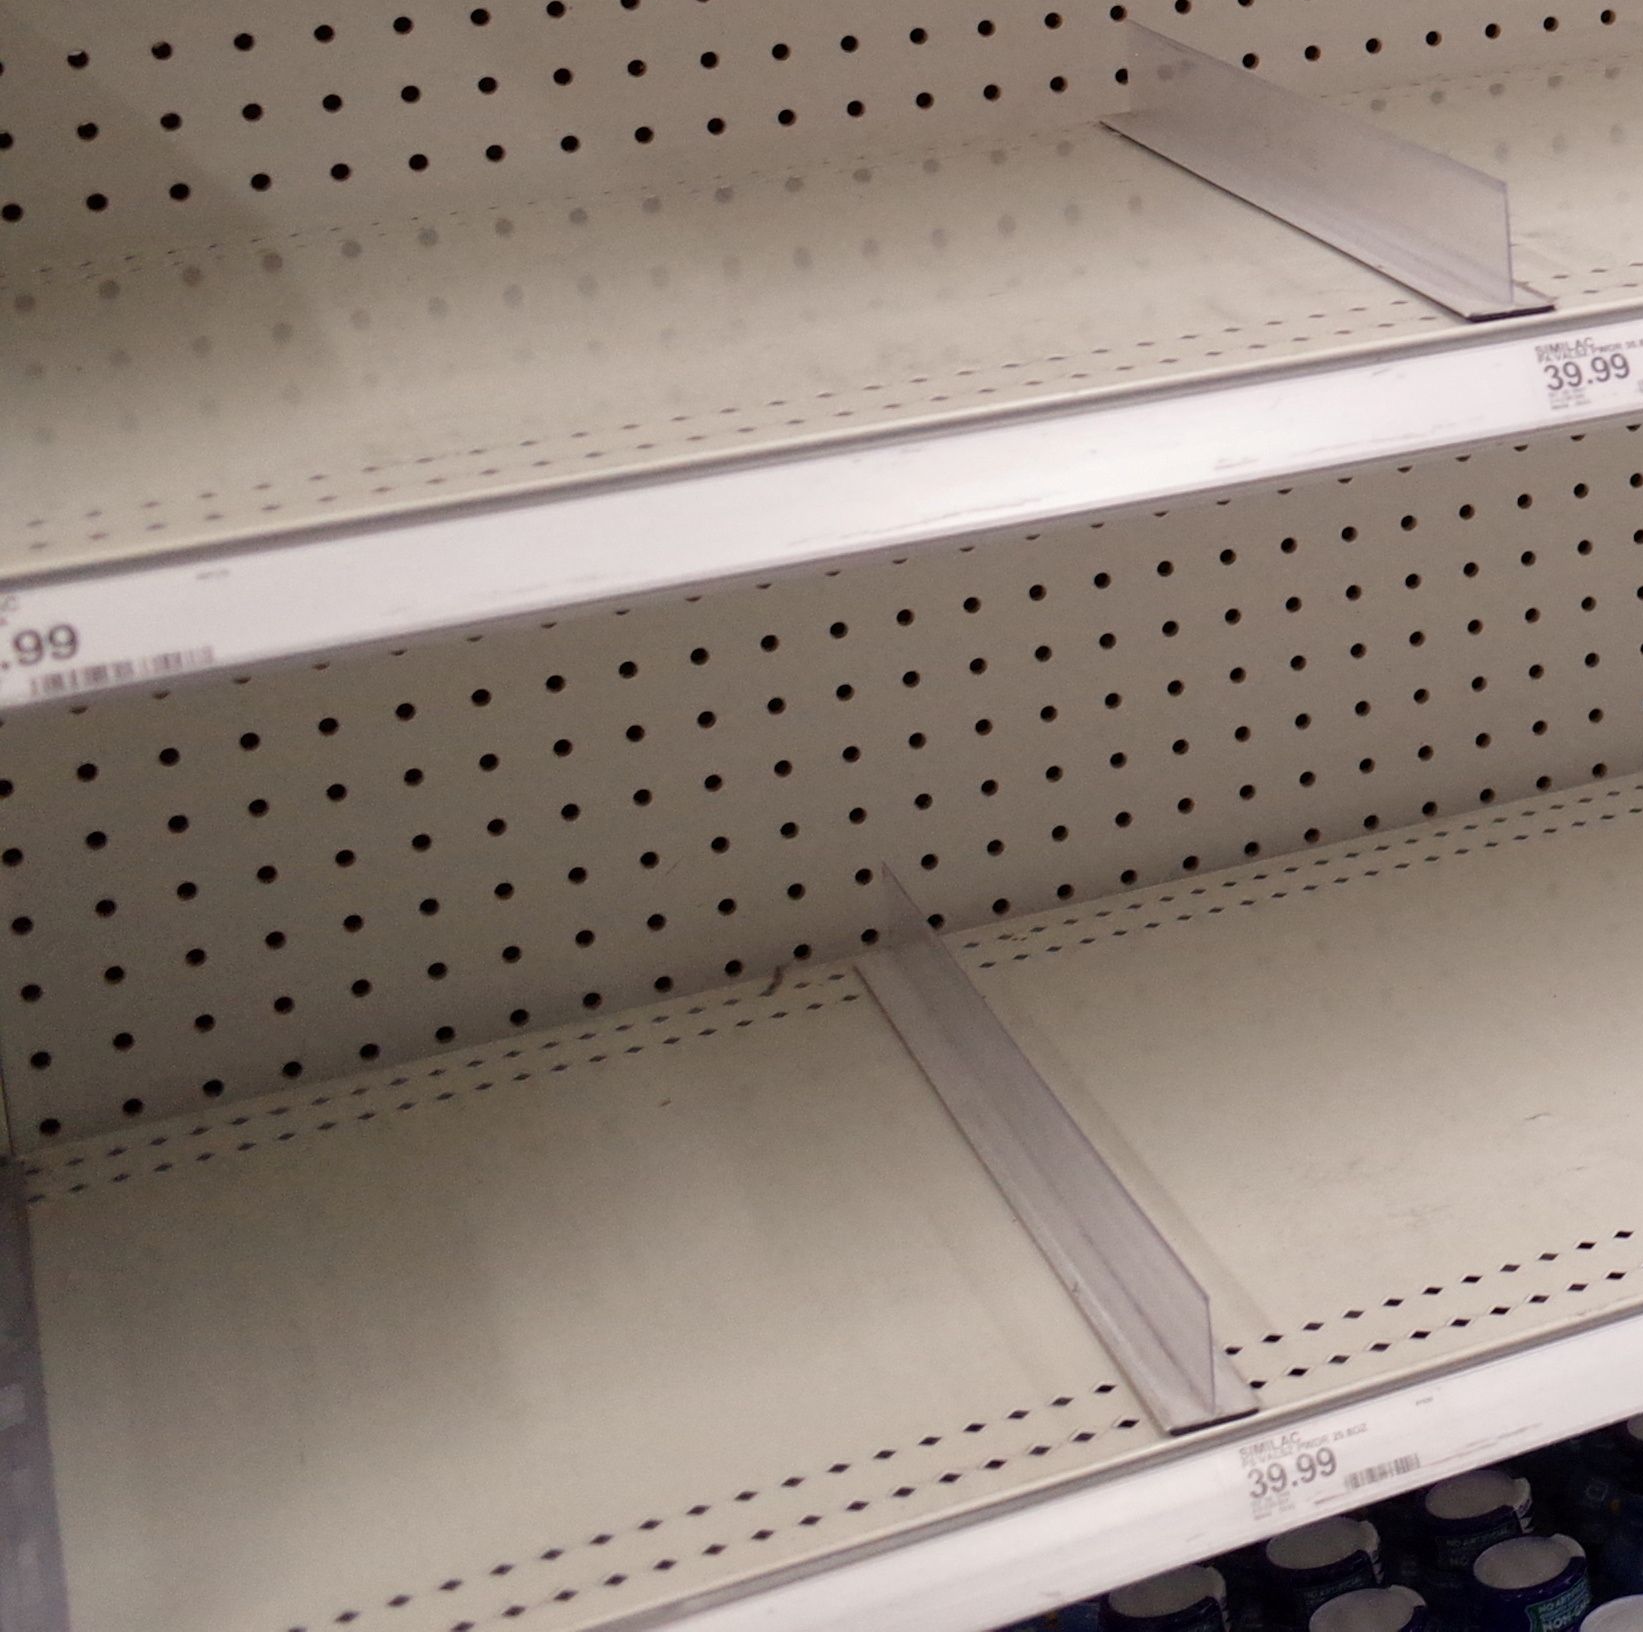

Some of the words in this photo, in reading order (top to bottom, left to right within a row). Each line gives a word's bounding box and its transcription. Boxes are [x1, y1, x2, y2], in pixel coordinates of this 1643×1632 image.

[1534, 336, 1595, 356] SIMILAC
[1543, 352, 1631, 391] 39.99
[1238, 1431, 1302, 1457] SIMILAC
[1246, 1446, 1338, 1500] 39.99
